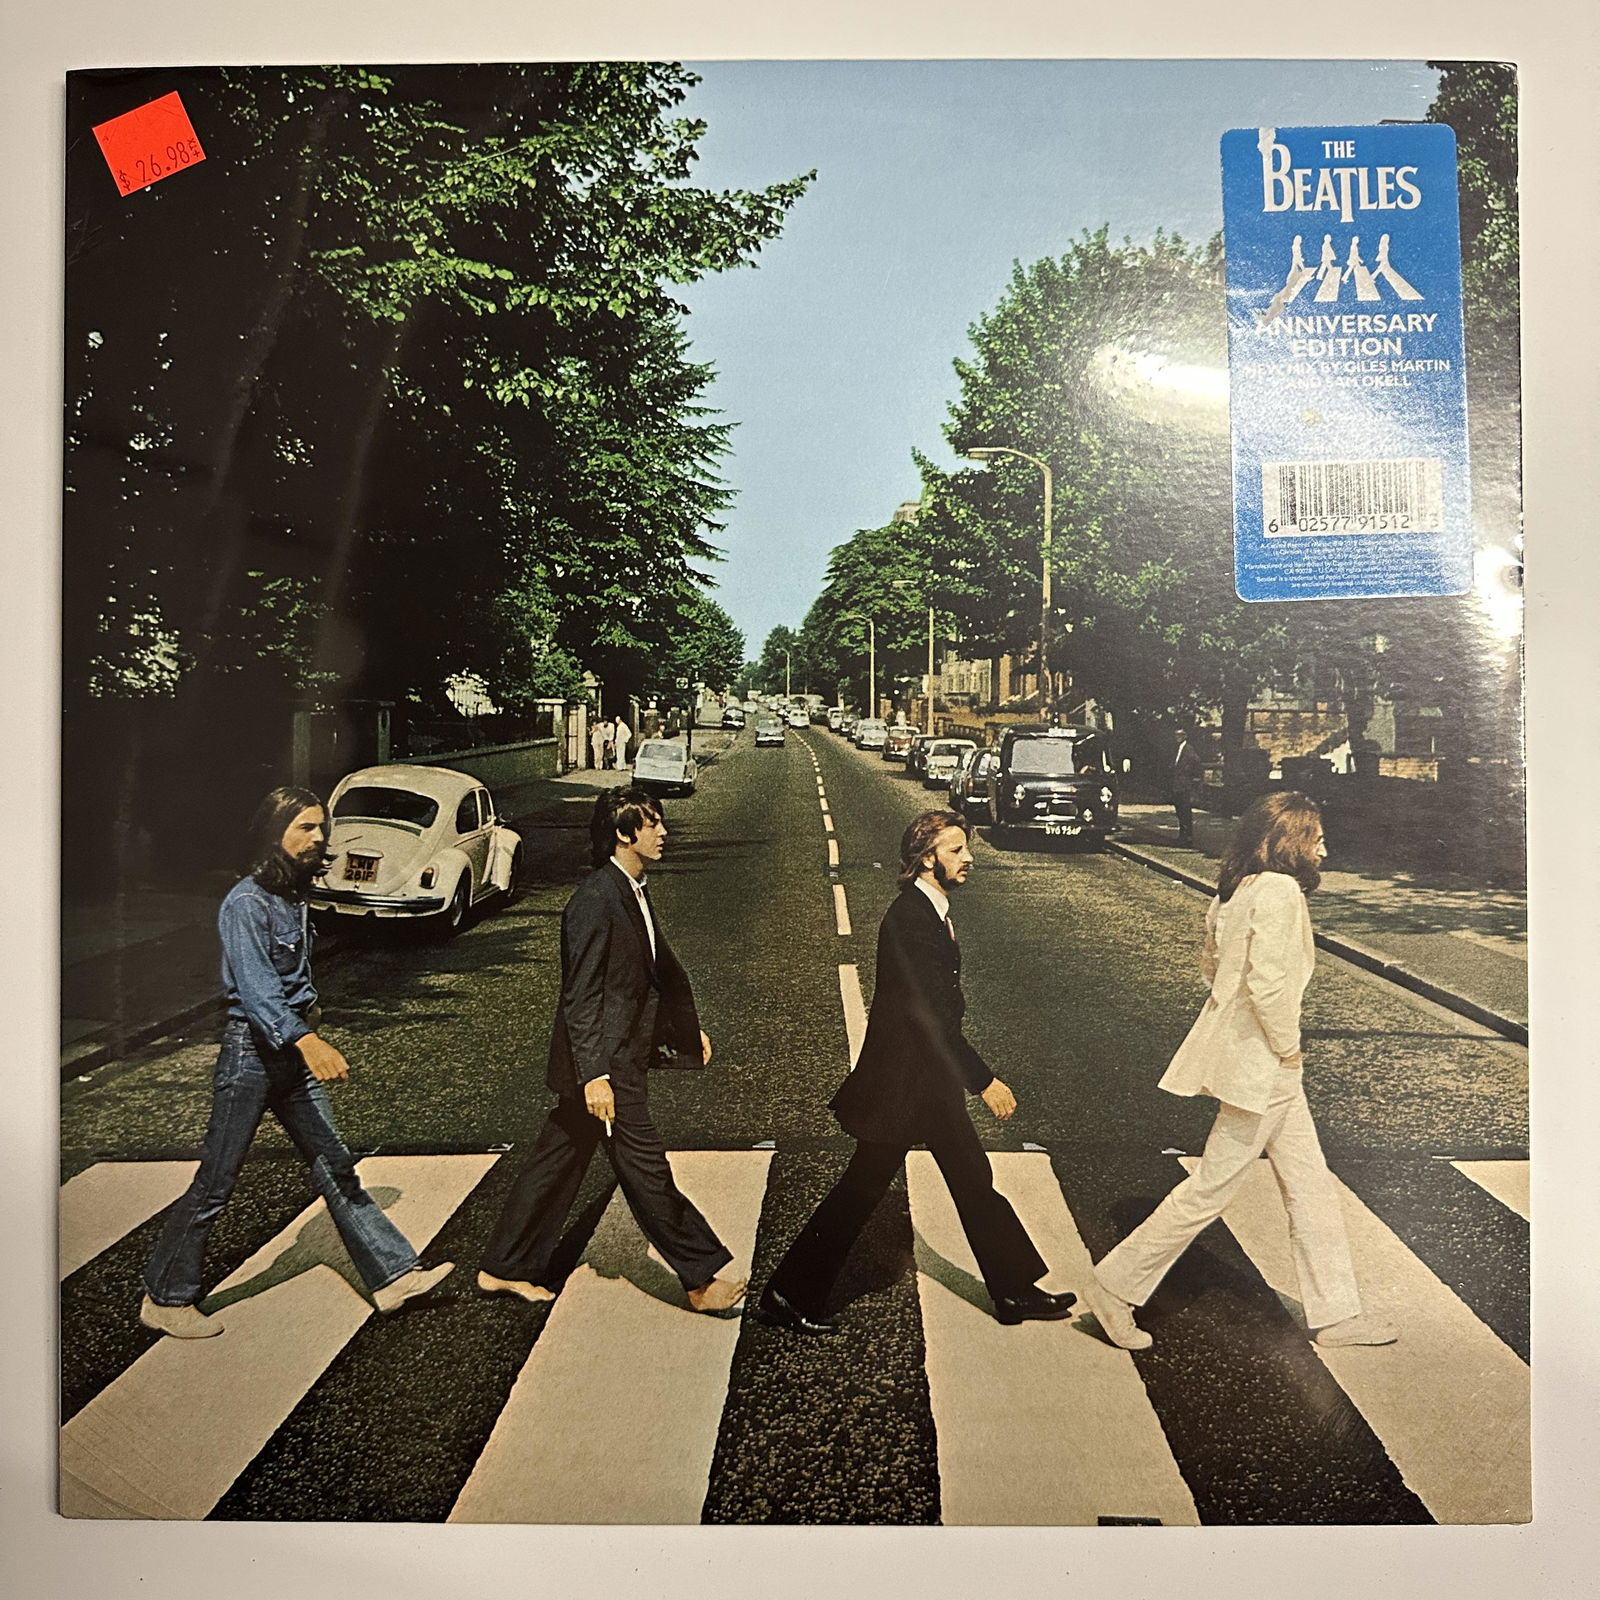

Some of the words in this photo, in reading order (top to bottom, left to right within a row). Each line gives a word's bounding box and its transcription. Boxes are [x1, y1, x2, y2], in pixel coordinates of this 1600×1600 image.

[1321, 140, 1356, 159] THE
[135, 141, 190, 183] 26.98
[1262, 142, 1422, 223] BEATLES
[1255, 313, 1438, 336] ANNIVERSARY
[1291, 337, 1403, 358] EDITION
[1321, 361, 1342, 373] BY
[1344, 360, 1387, 373] GILES
[1391, 359, 1451, 372] MARTIN
[1361, 374, 1412, 388] OKELL
[1268, 518, 1279, 533] 6
[1298, 515, 1350, 532] 02577
[1358, 514, 1410, 530] 91512
